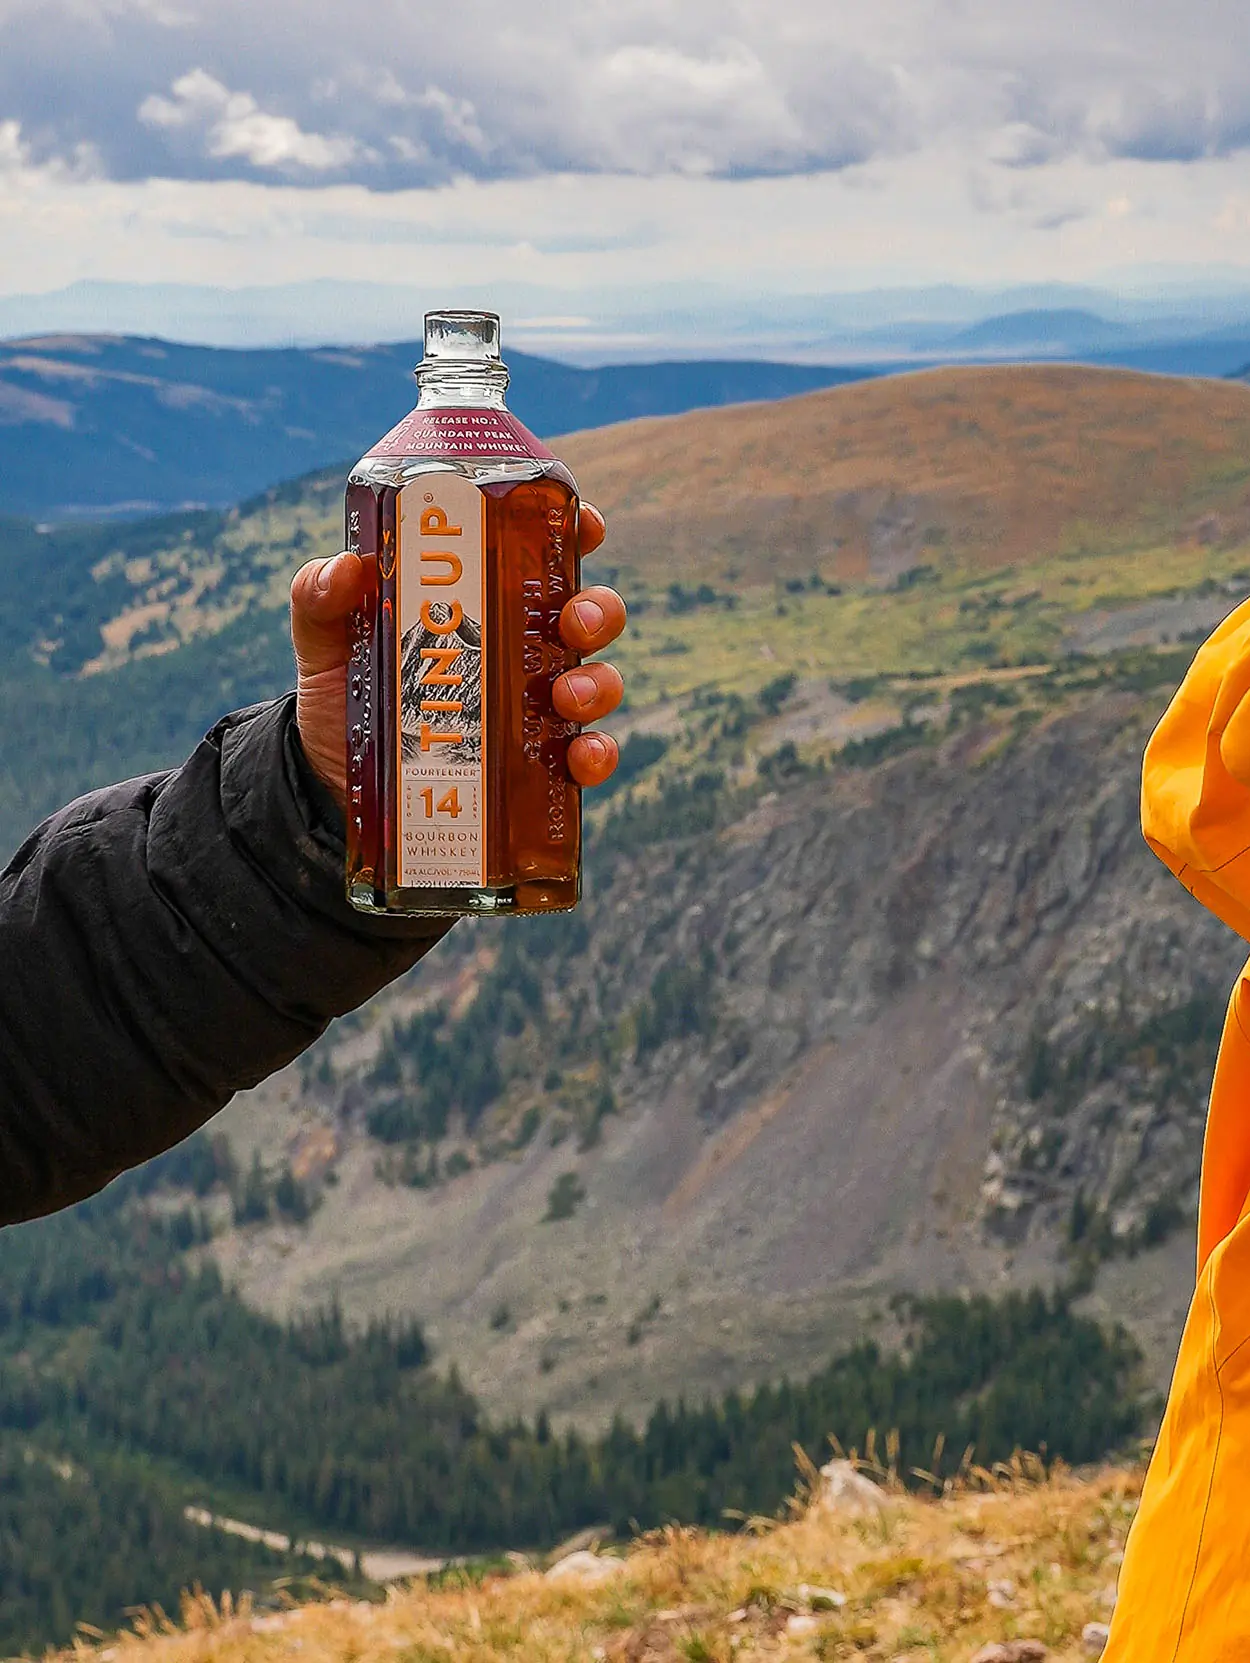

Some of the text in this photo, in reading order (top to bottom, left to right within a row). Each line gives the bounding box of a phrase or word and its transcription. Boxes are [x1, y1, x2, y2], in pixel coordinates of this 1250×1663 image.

[422, 416, 499, 425] RELEASE NO.2
[414, 430, 513, 440] QUANDARY PEAK
[405, 442, 528, 452] MOUNTAIN WHISKEY
[522, 578, 542, 675] WITH
[405, 767, 477, 777] FOURTEENER
[419, 786, 463, 818] 14
[405, 831, 478, 842] BOURBON
[406, 847, 478, 857] WHISKEY
